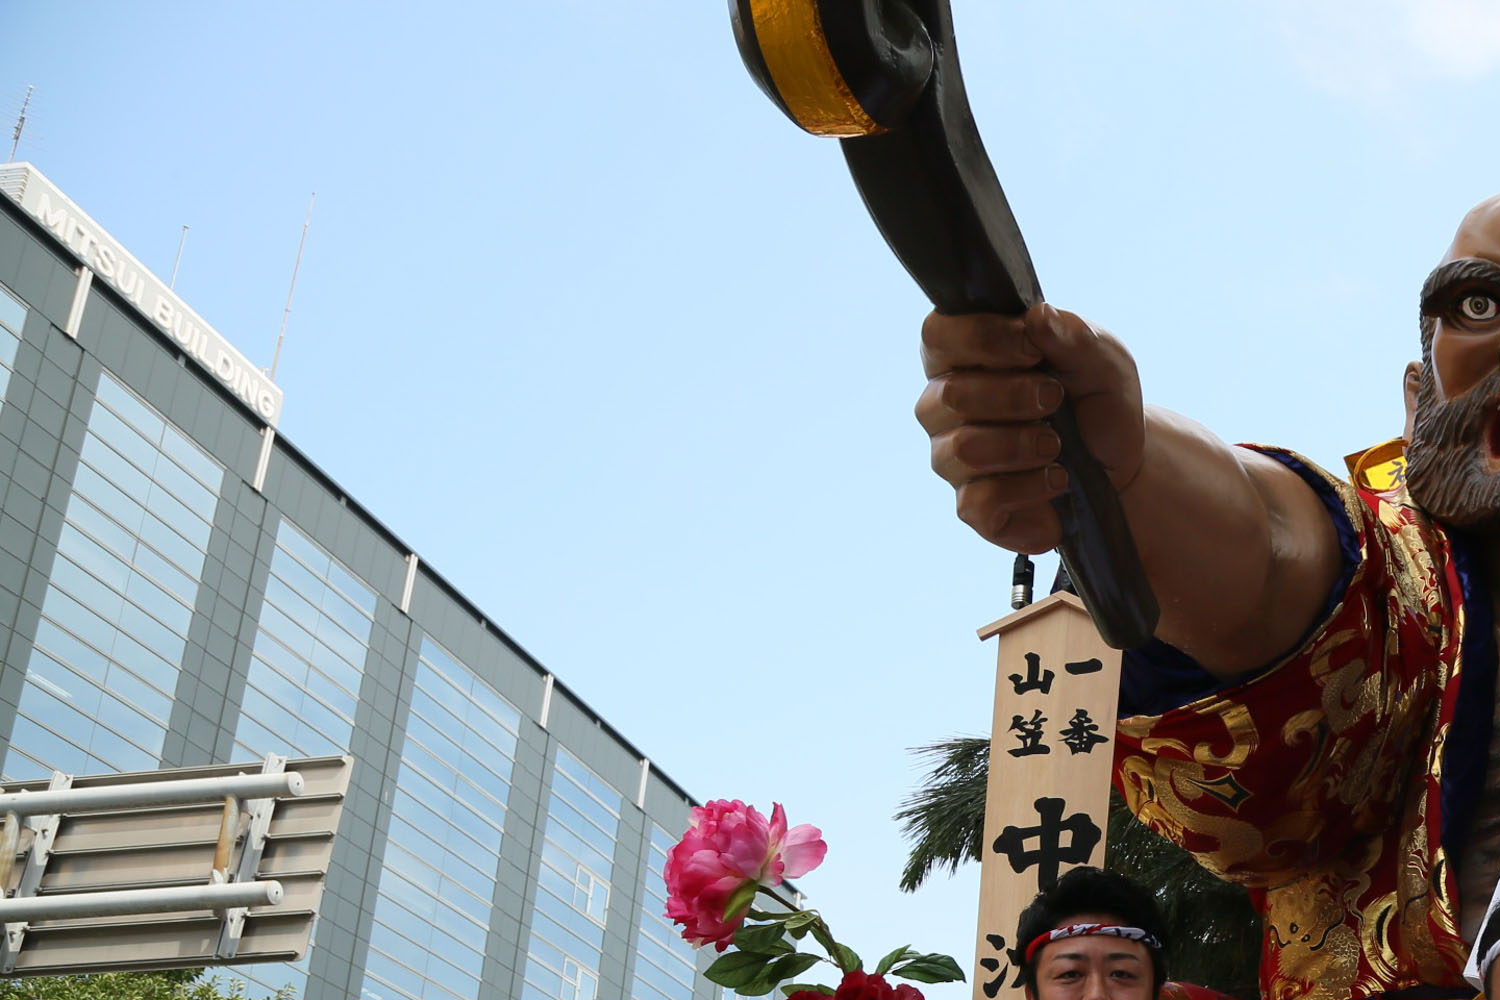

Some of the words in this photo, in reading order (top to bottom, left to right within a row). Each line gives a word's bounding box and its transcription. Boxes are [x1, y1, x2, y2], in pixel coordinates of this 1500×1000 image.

[37, 193, 146, 302] MITSUI
[153, 296, 275, 416] BUILDING
[1007, 651, 1055, 757] 山笠
[1057, 656, 1109, 756] 一番
